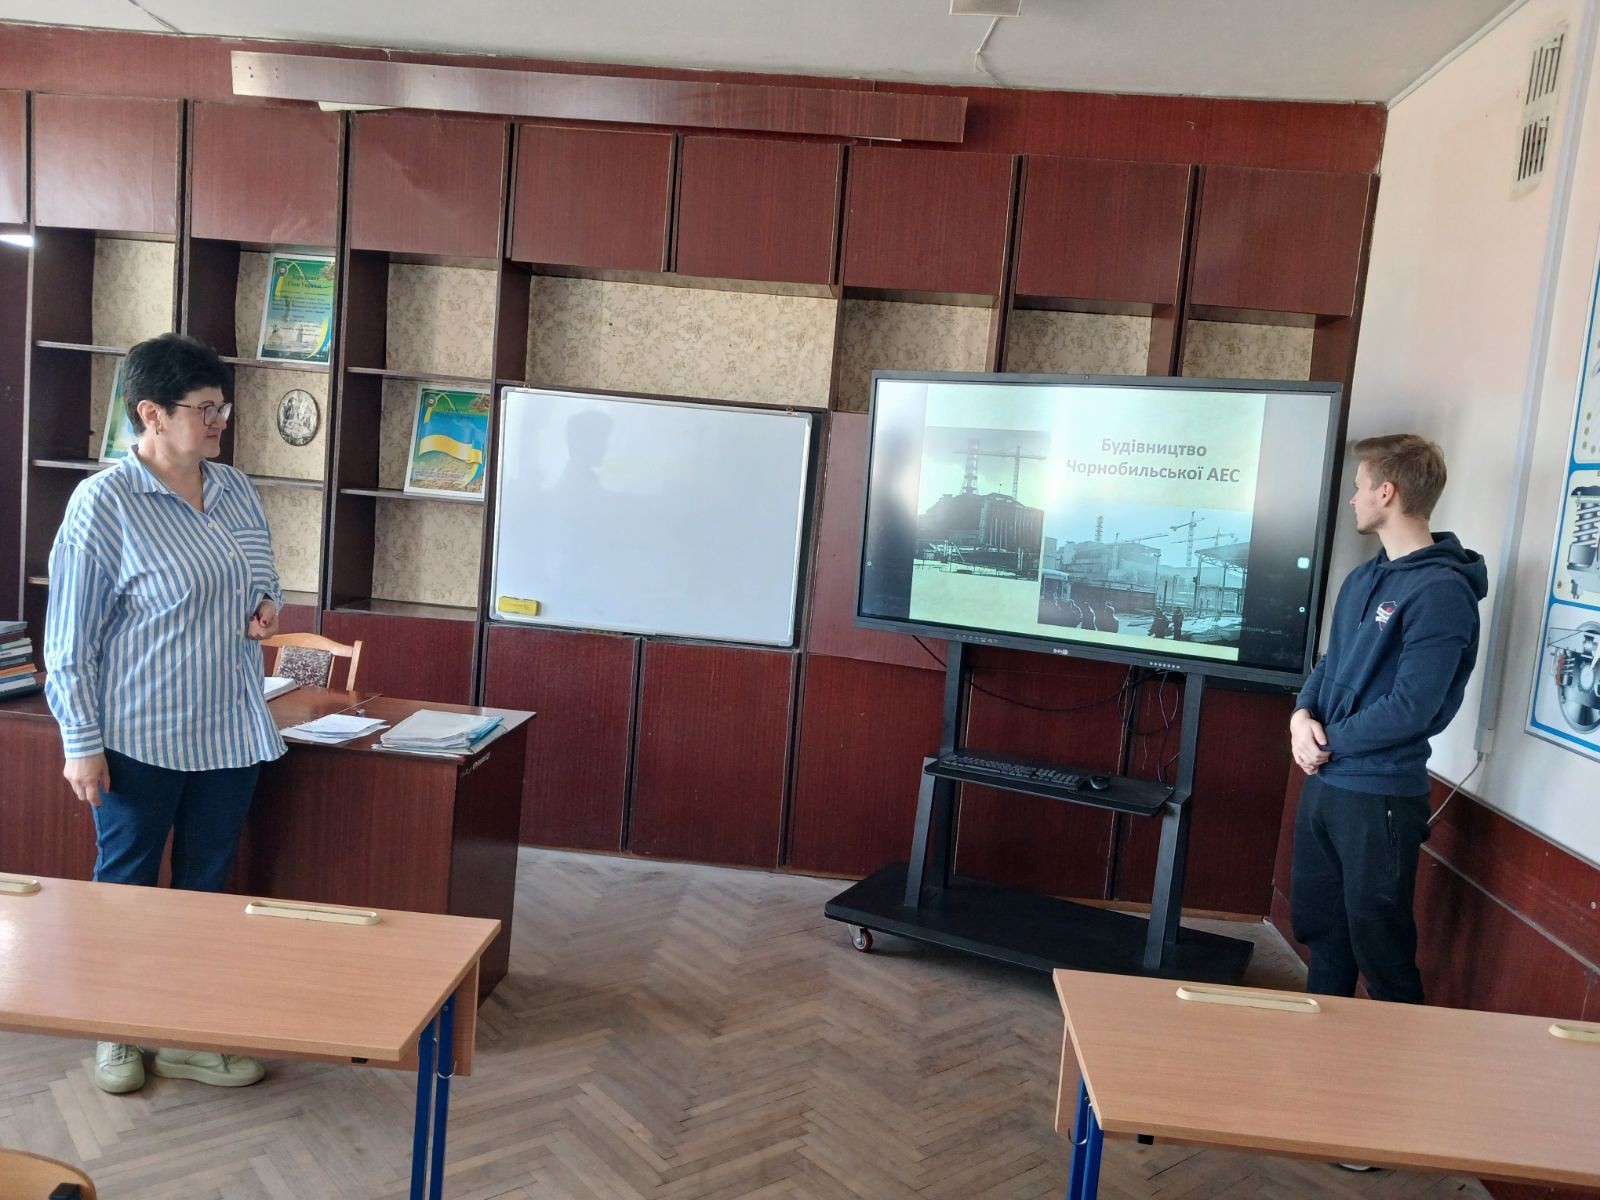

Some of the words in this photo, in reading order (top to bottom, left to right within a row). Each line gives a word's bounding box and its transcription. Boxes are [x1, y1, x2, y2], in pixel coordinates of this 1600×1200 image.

[1102, 439, 1207, 458] Будівництво
[1067, 460, 1204, 481] Чорнобильської
[1207, 467, 1241, 483] АЕС
